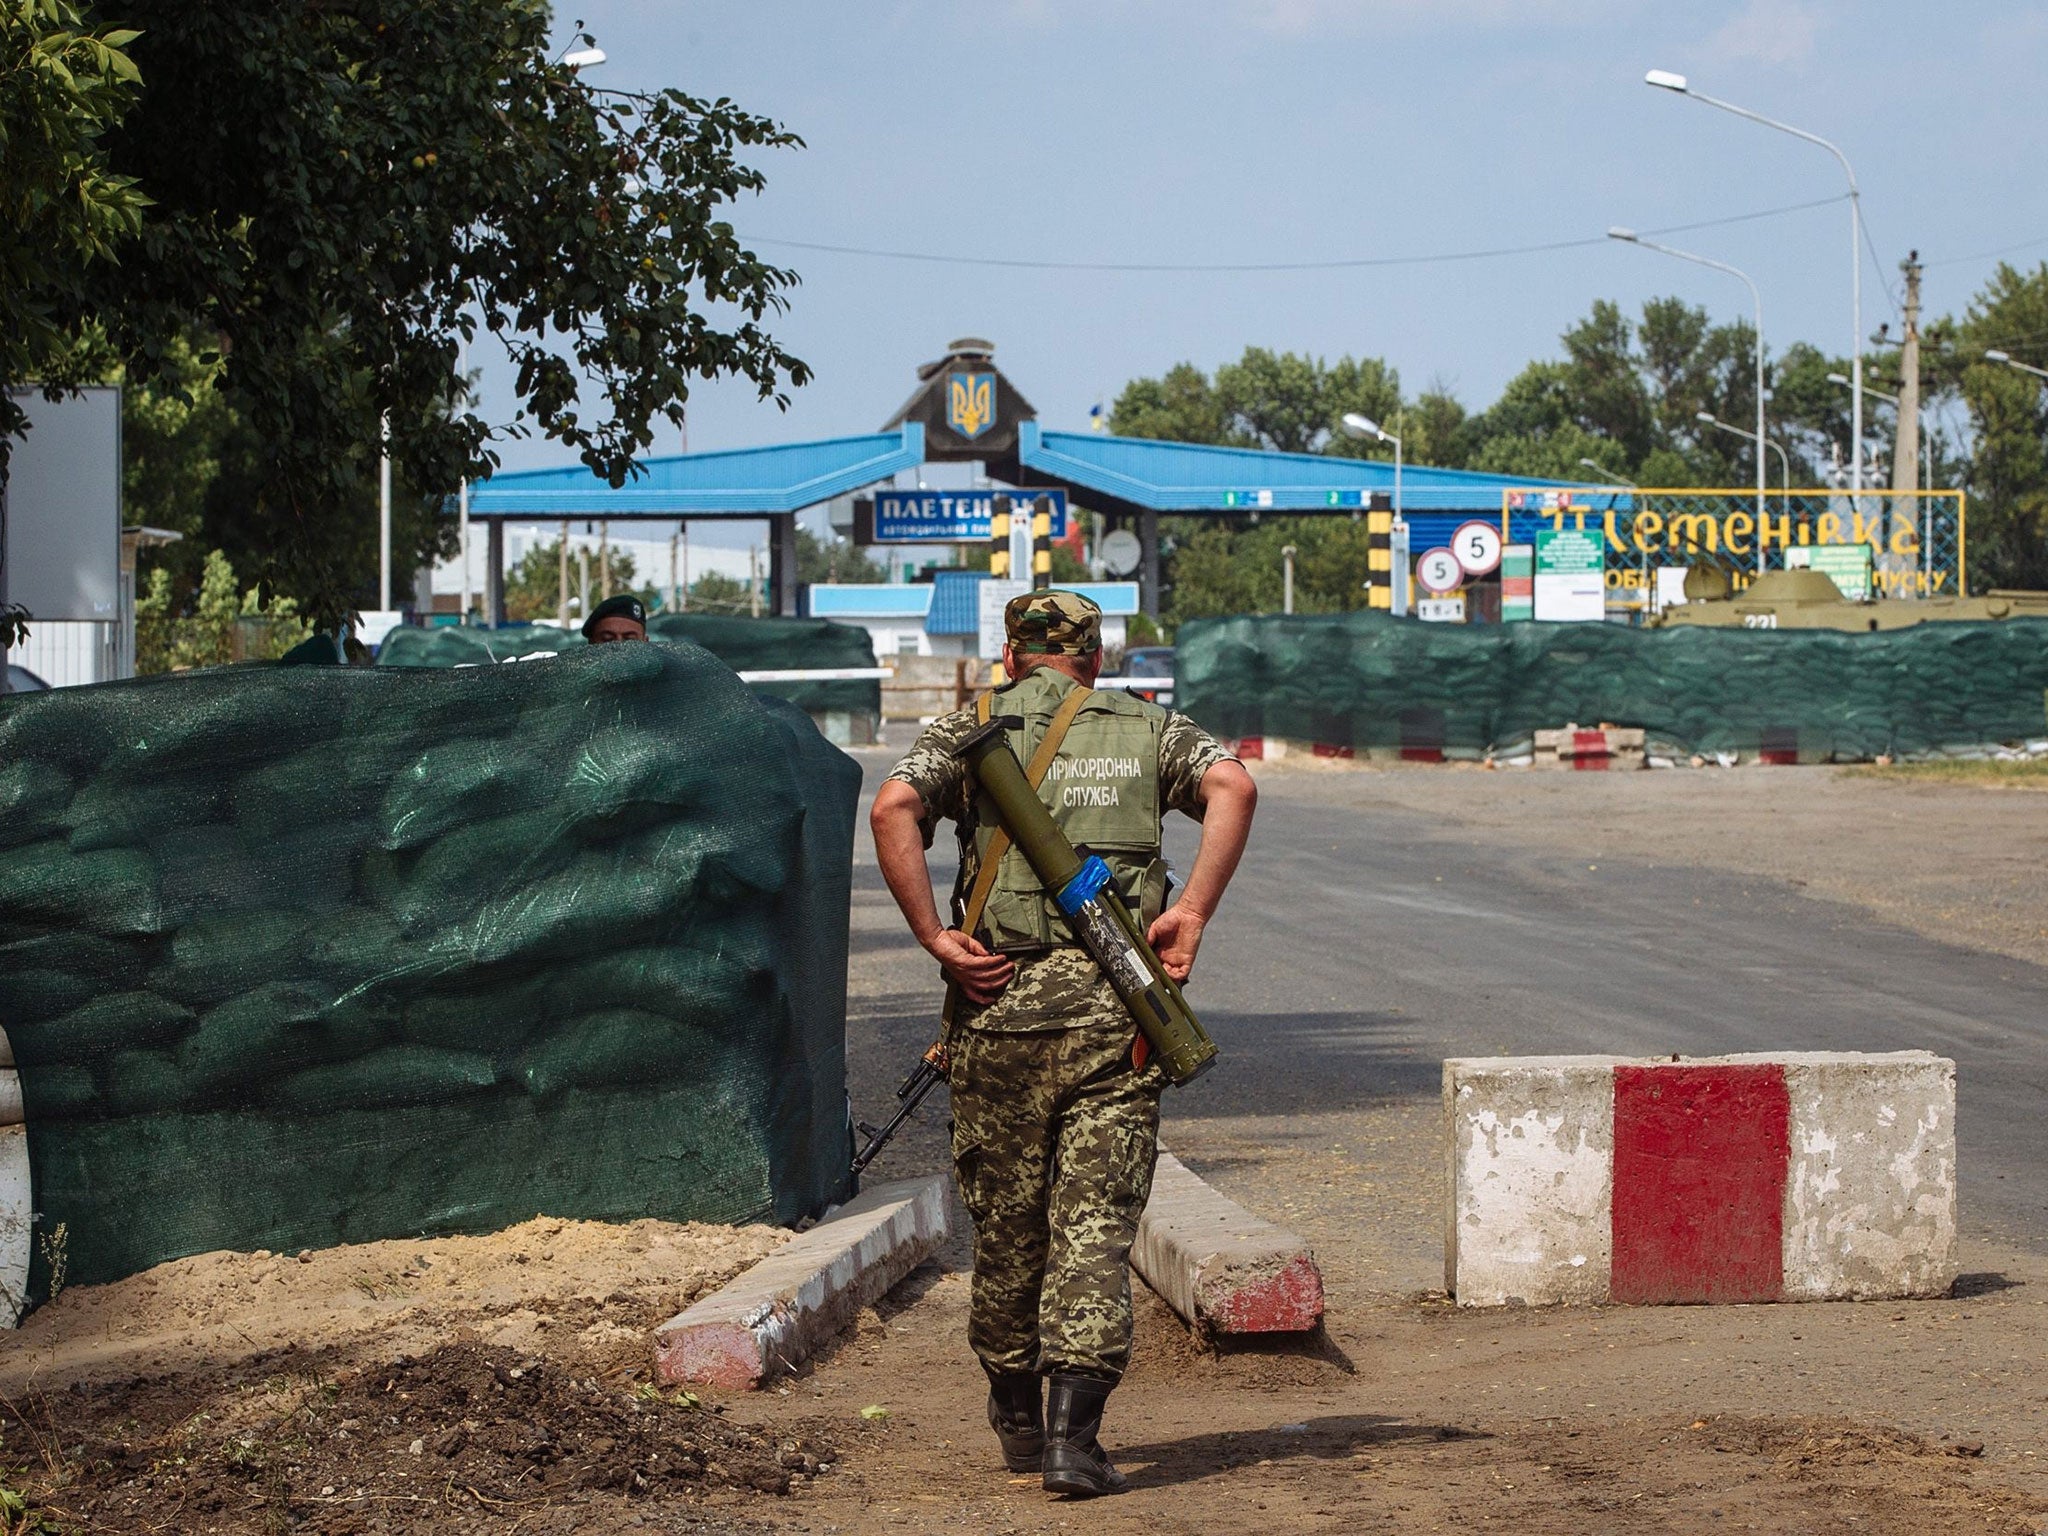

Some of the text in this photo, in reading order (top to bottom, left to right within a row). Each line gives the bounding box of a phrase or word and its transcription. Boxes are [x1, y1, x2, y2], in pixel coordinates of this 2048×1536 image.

[883, 498, 1059, 519] ПЛЕТЕН
[1471, 536, 1484, 558] 5
[1434, 561, 1446, 579] 5
[1872, 569, 1947, 592] ПУСКУ
[1063, 785, 1119, 807] СЛУЖБА
